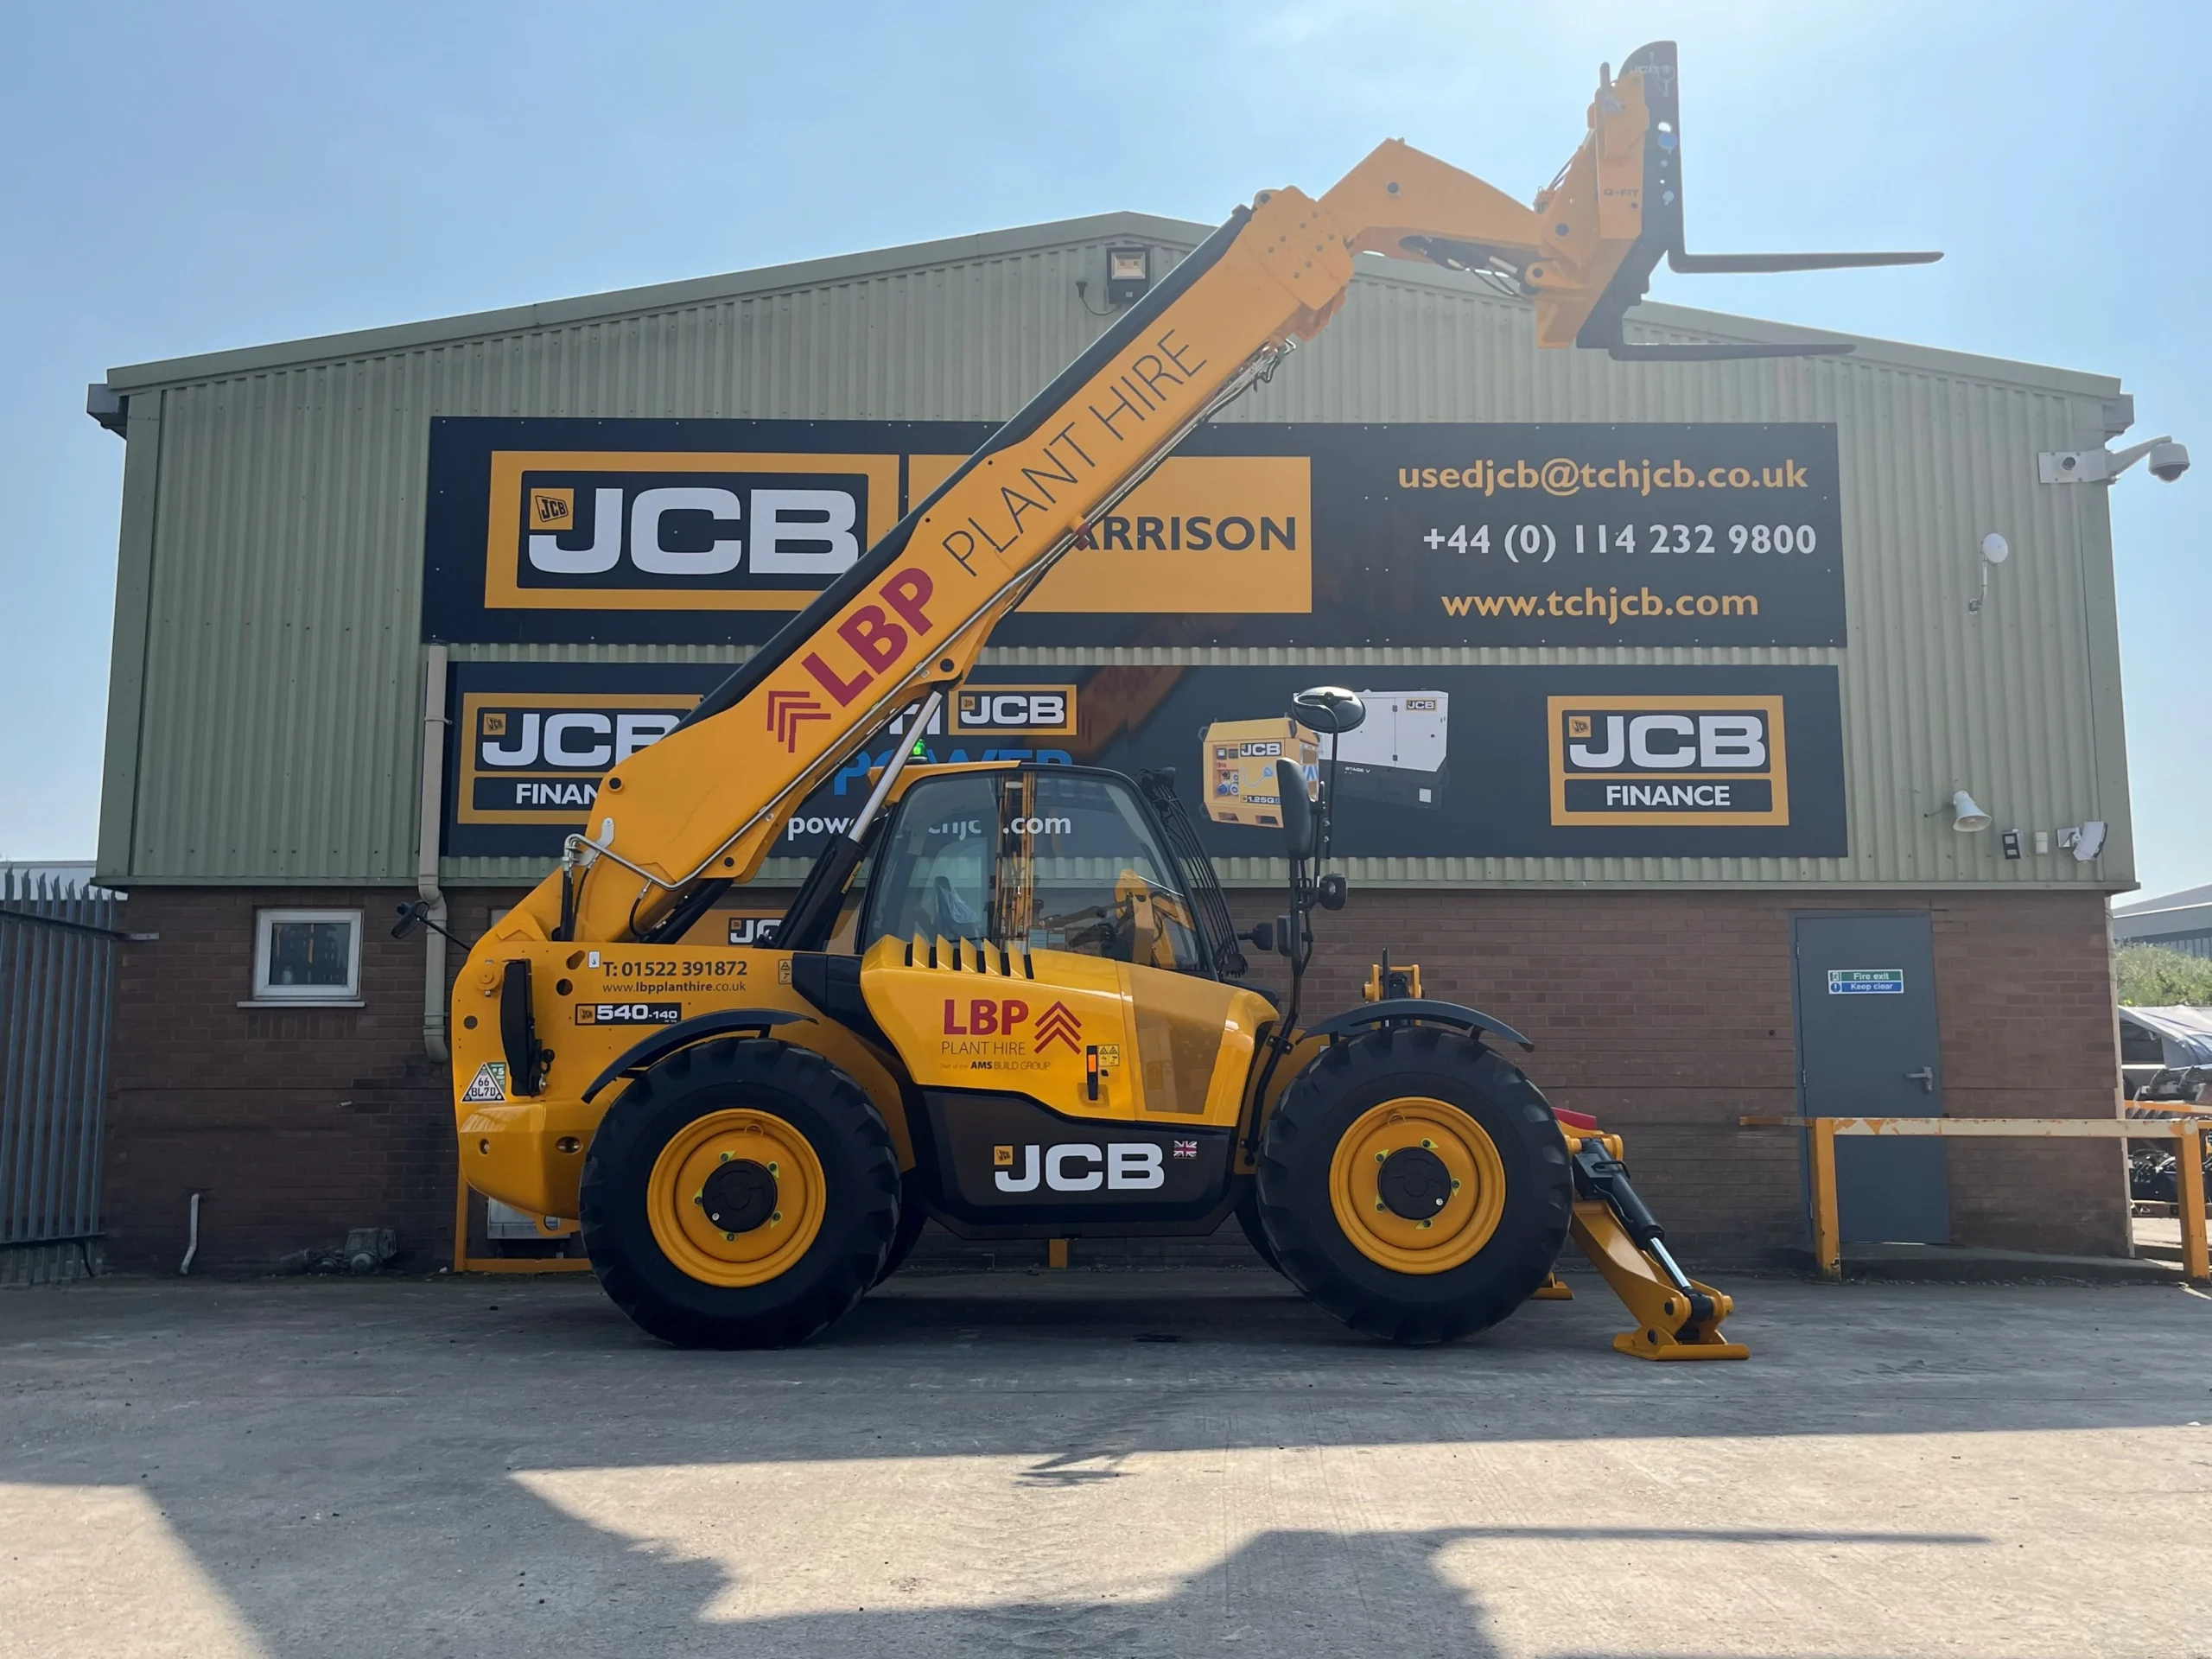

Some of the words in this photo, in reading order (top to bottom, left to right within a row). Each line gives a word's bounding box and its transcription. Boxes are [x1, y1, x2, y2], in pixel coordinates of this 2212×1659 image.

[1398, 458, 1808, 496] usedjcb@tchjcb.co.uk
[539, 498, 567, 518] JCB
[801, 568, 933, 708] LBP
[943, 422, 1096, 576] PLANT
[1089, 329, 1207, 441] HIRE
[529, 487, 859, 575] JCB
[1423, 524, 1491, 554] +44
[1504, 524, 1556, 563] (0)
[1576, 524, 1636, 554] 114
[1649, 524, 1715, 554] 232
[1728, 524, 1816, 554] 9800
[1441, 587, 1759, 625] www.tchjcb.com
[961, 696, 1065, 724] JCB
[1408, 701, 1435, 709] JCB
[1241, 743, 1281, 756] JCB
[1569, 715, 1766, 768] JCB
[516, 783, 598, 804] FINAN
[1606, 785, 1731, 806] FINANCE
[730, 919, 782, 943] JC
[602, 961, 618, 977] T:
[621, 961, 677, 977] 01522
[682, 960, 747, 976] 391872
[602, 981, 747, 995] www.lbpplanthire.co.uk
[596, 1004, 678, 1020] 540-140
[944, 999, 1029, 1035] LBP
[941, 1040, 990, 1055] PLANT
[994, 1041, 1027, 1055] HIRE
[970, 1061, 992, 1070] AMS
[994, 1061, 1019, 1071] BUILD
[1020, 1061, 1051, 1071] GROUP
[471, 1087, 496, 1097] BL7D
[478, 1077, 490, 1087] 66
[995, 1143, 1165, 1192] JCB
